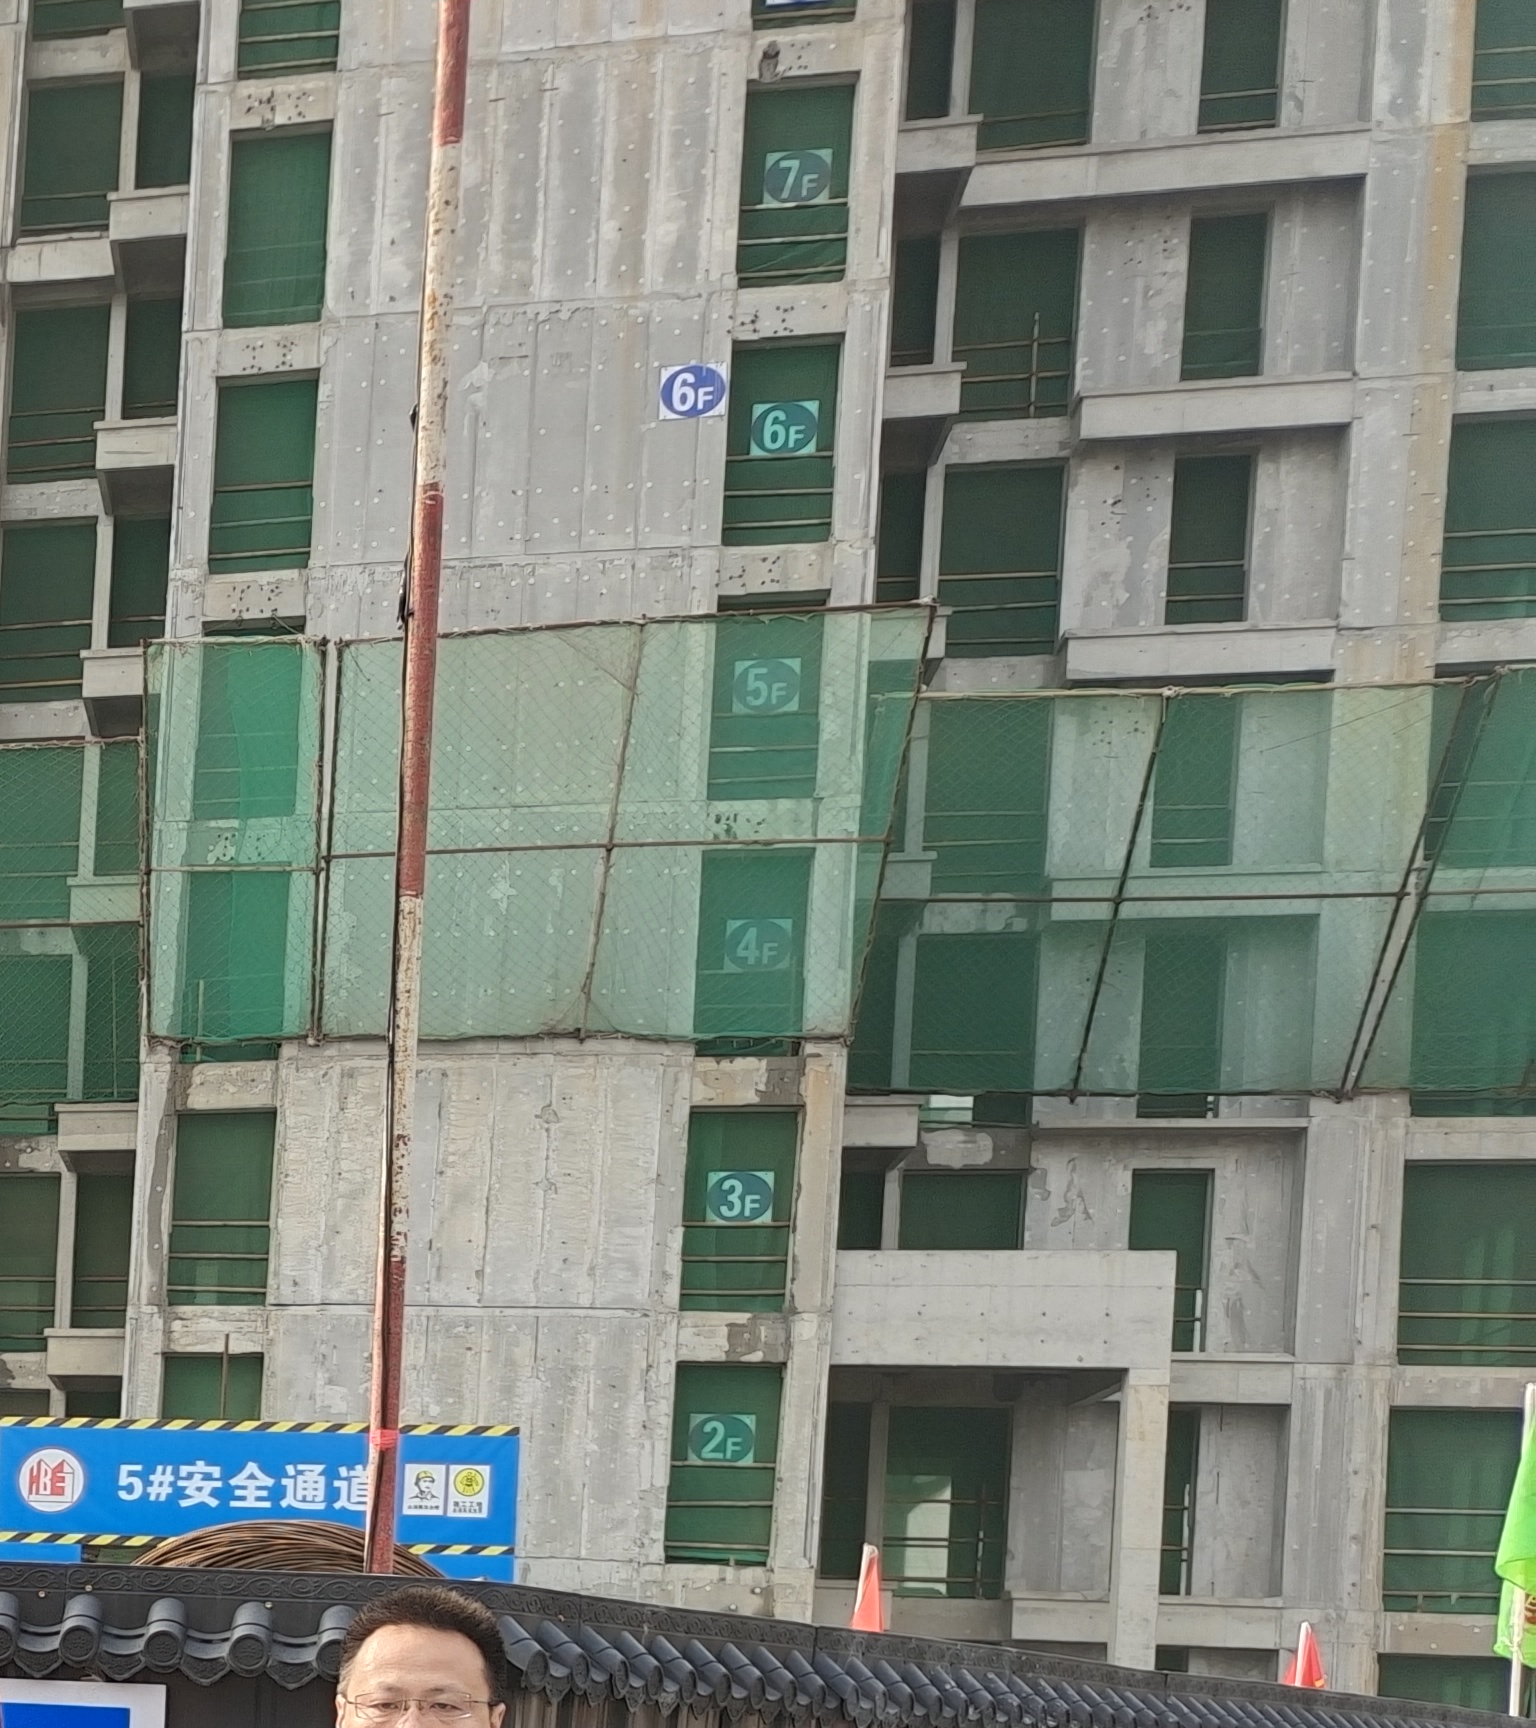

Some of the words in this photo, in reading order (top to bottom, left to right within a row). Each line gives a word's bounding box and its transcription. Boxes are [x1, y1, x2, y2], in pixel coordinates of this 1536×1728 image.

[777, 158, 819, 200] 7F
[671, 371, 715, 413] 6F
[762, 409, 806, 451] 6F
[744, 666, 787, 707] 5F
[735, 926, 778, 966] 4F
[719, 1178, 761, 1218] 3F
[700, 1419, 743, 1460] 2F
[117, 1459, 370, 1511] 5#安全通道
